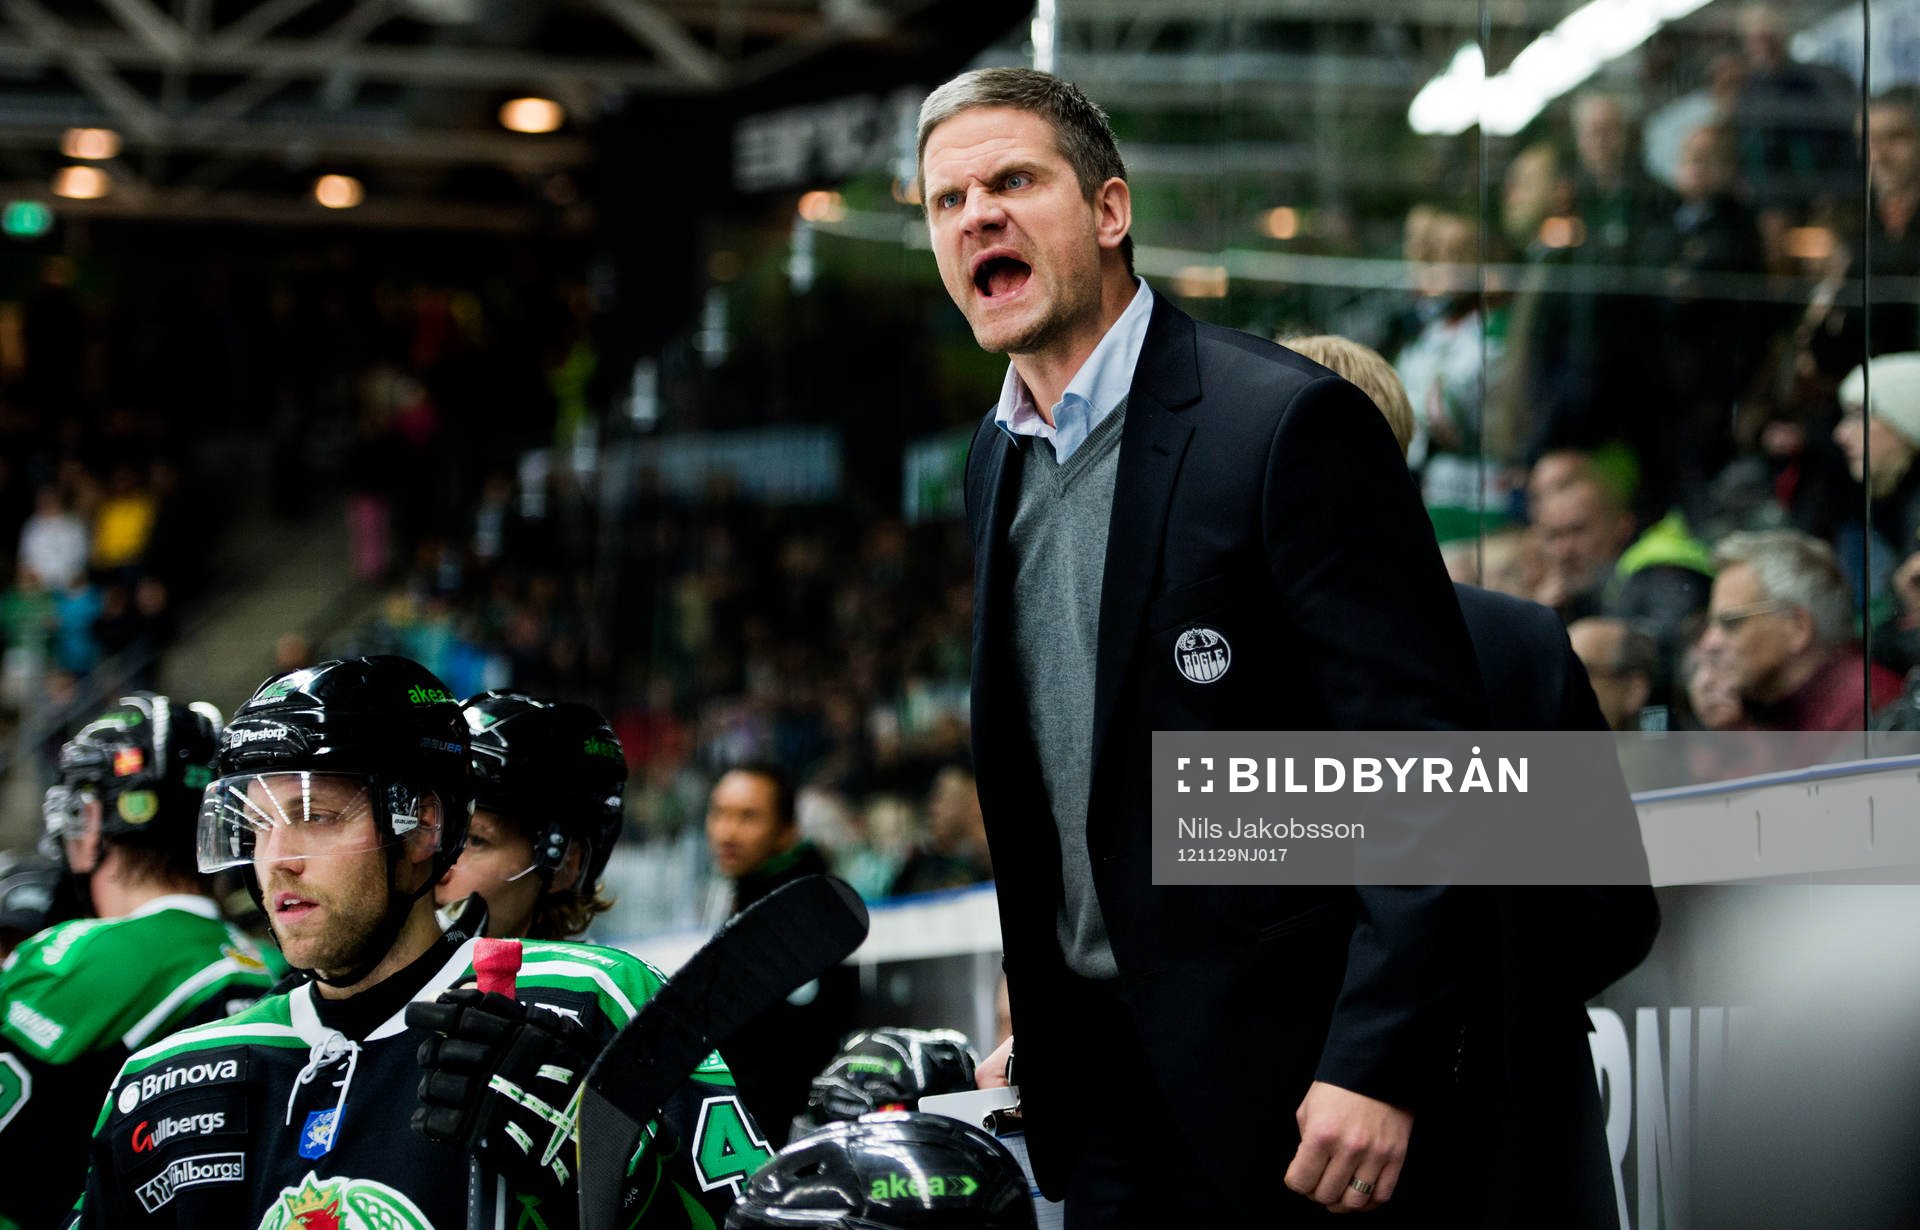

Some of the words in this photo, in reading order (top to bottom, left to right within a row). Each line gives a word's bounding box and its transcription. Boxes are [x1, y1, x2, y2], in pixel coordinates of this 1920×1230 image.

[1182, 648, 1226, 681] RÖGLE
[408, 684, 448, 704] akea
[243, 727, 288, 742] Perstorp
[141, 1059, 238, 1102] Brinova
[131, 1112, 225, 1153] Gullbergs
[871, 1172, 946, 1200] akea
